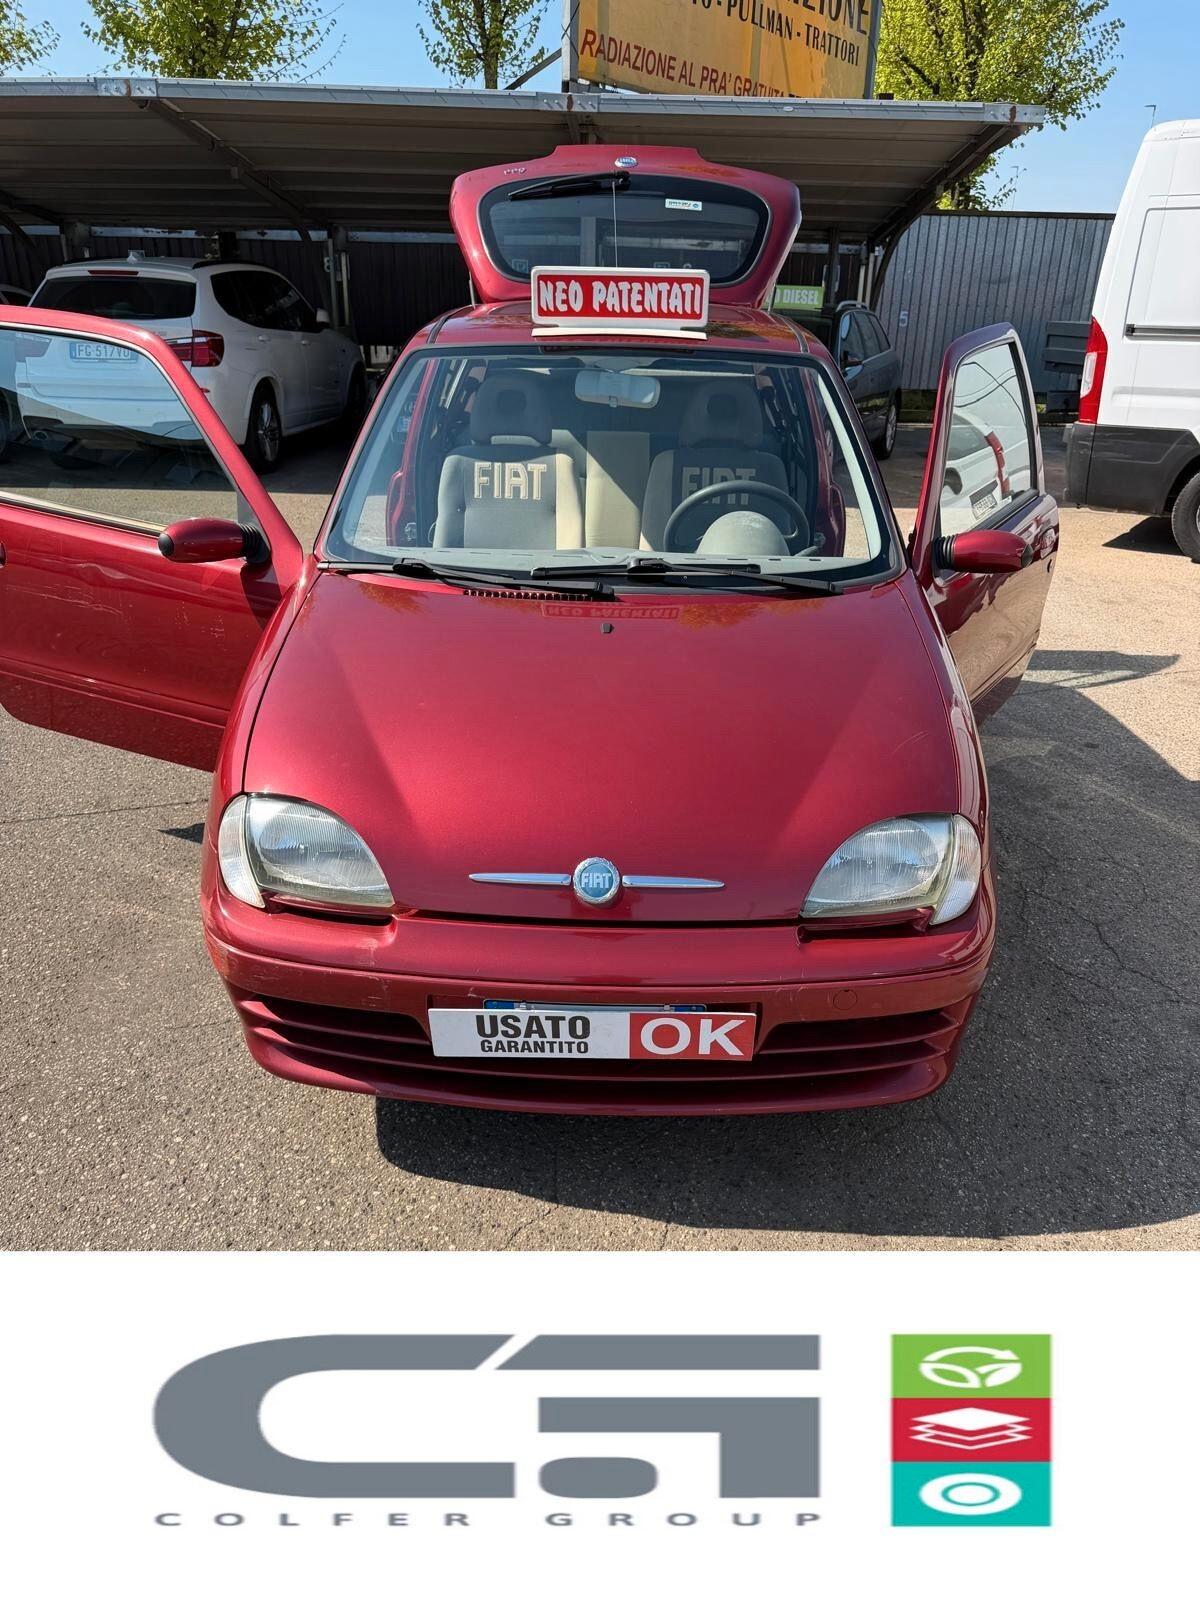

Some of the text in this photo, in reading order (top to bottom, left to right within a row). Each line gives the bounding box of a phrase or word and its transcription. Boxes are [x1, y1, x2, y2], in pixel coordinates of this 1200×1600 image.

[727, 0, 793, 40] PULLMAN
[805, 23, 860, 66] TRATTORI
[580, 29, 676, 82] RADIAZIONE
[679, 60, 696, 87] AL
[734, 75, 784, 97] GRATU
[539, 279, 701, 315] NEO PATENTATI
[782, 288, 819, 305] DIESEL
[77, 343, 92, 358] FG
[473, 461, 547, 500] FIAT
[681, 466, 756, 505] FIAT
[581, 872, 613, 889] FIAT
[476, 1014, 591, 1039] USATO
[640, 1017, 747, 1056] OK
[480, 1039, 589, 1054] GARANTITO
